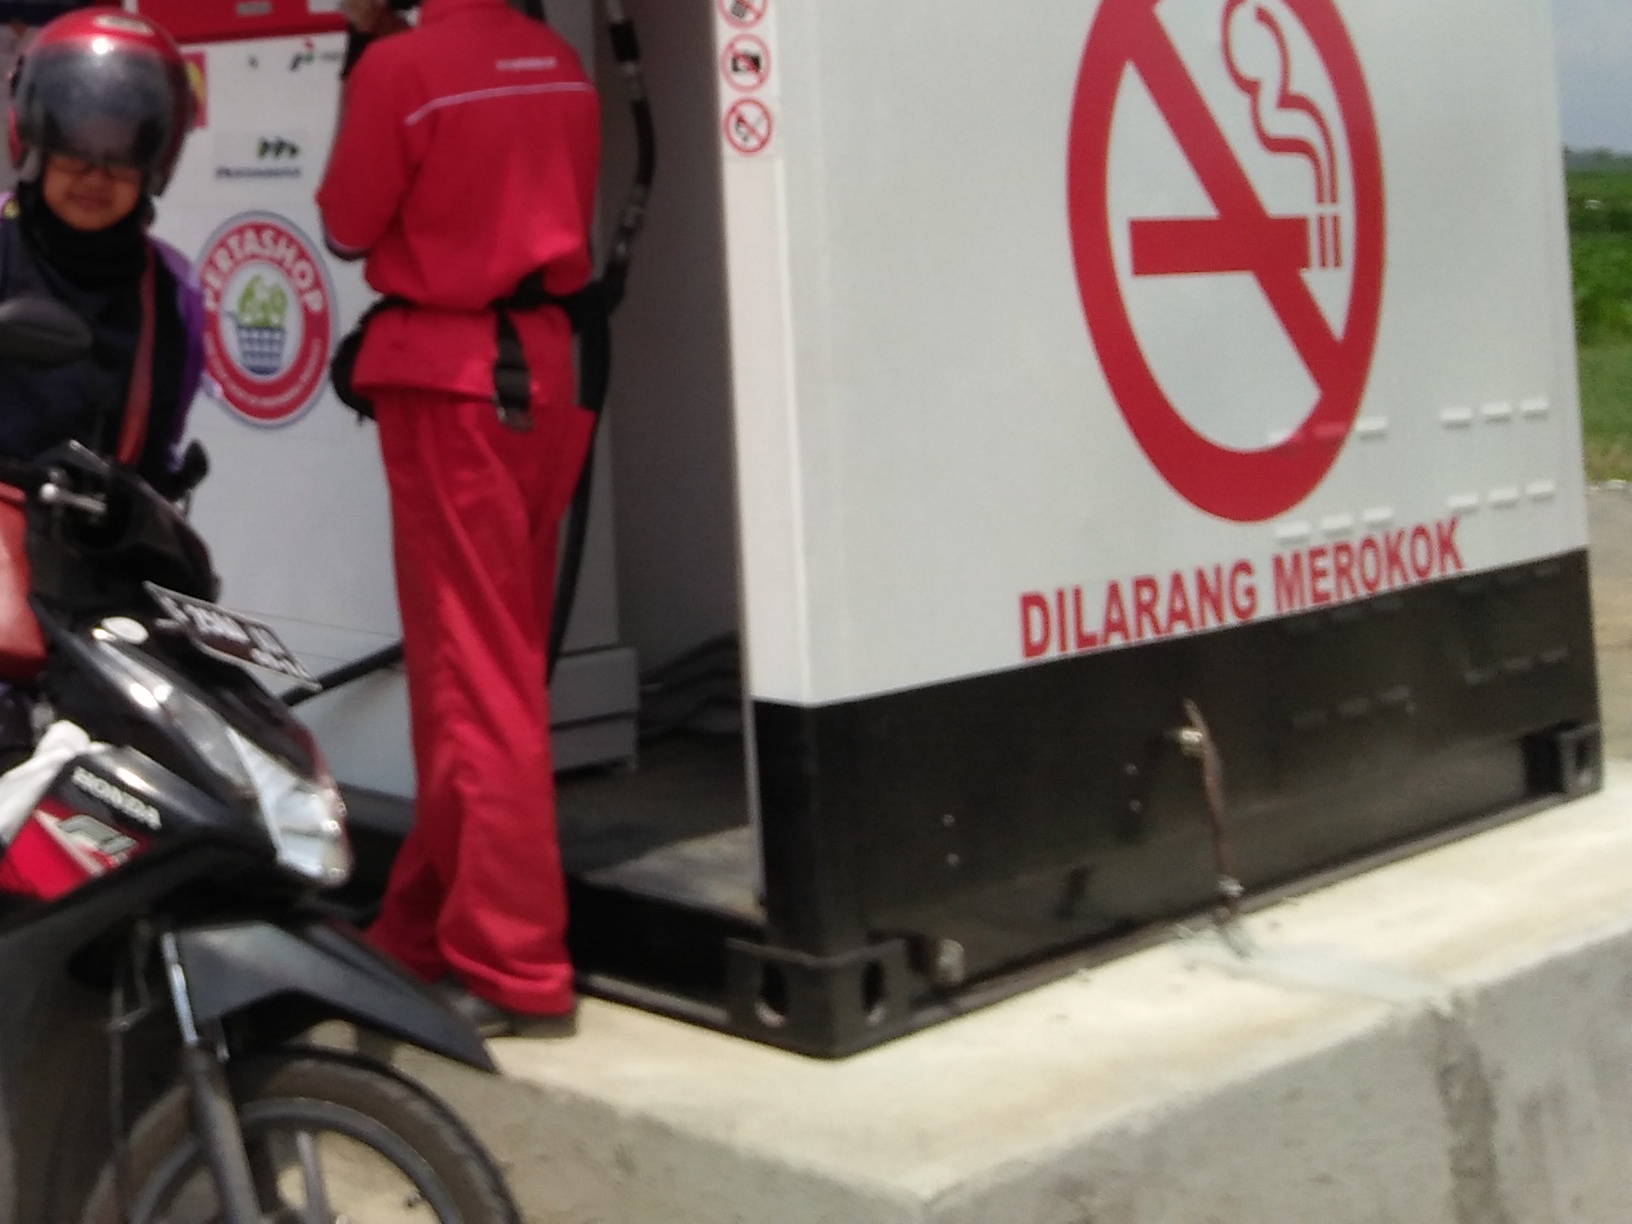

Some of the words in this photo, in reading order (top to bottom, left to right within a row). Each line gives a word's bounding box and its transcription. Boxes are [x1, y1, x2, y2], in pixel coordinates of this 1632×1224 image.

[1018, 558, 1258, 660] DILARANG
[1271, 516, 1463, 616] MEROKOK
[71, 765, 163, 830] HONDA
